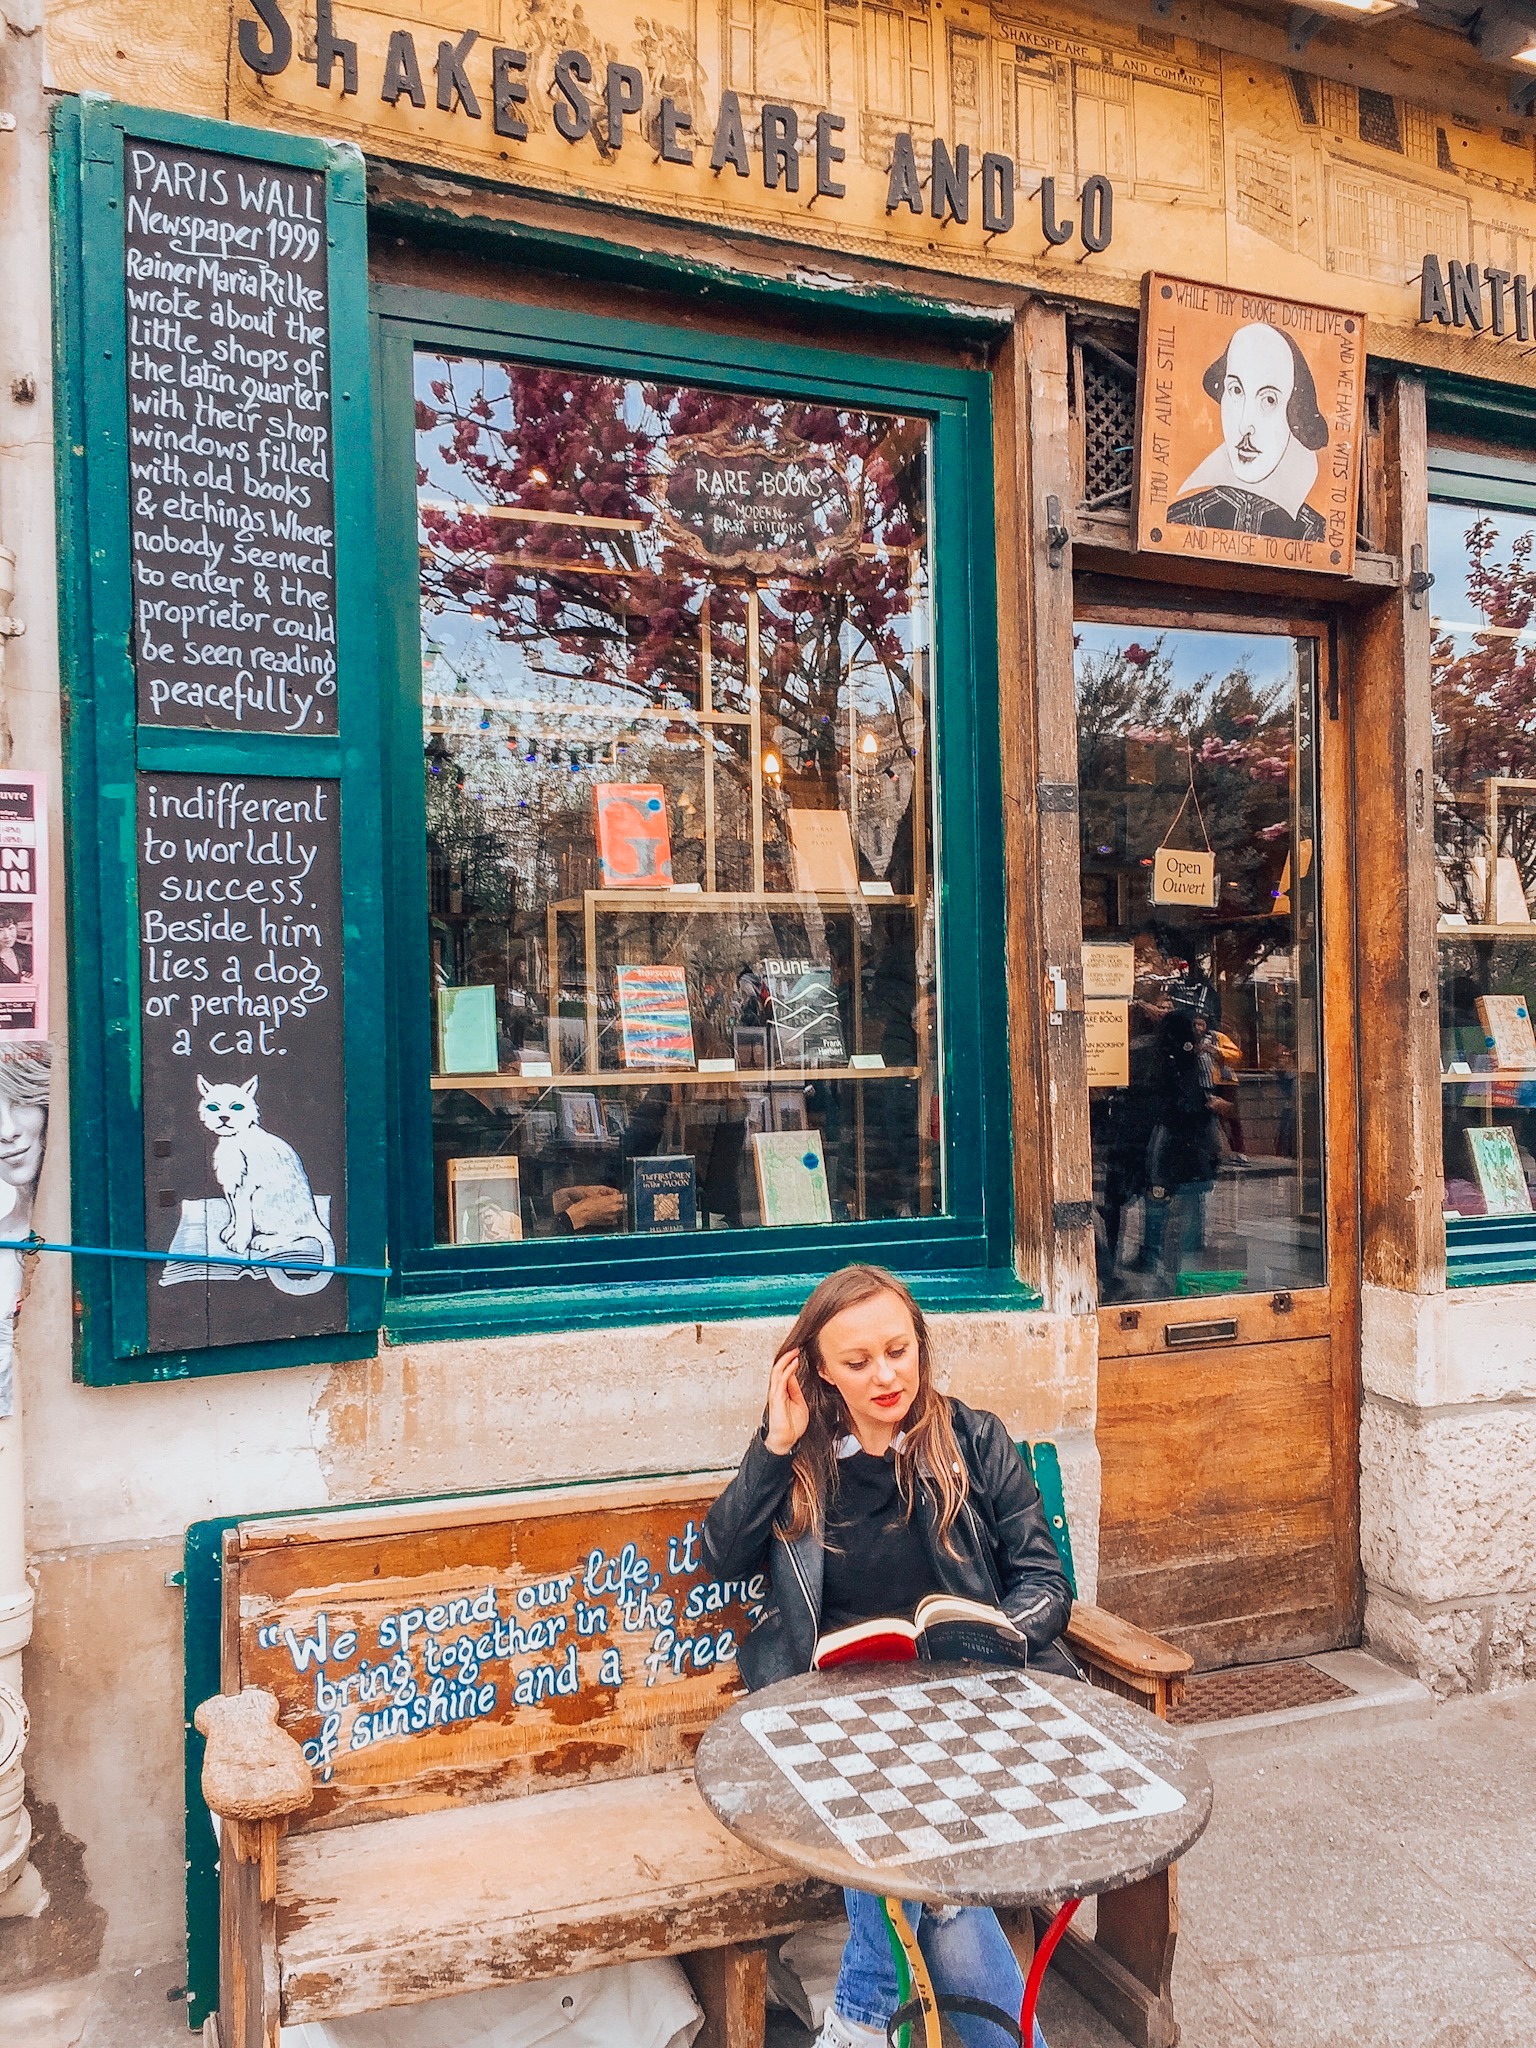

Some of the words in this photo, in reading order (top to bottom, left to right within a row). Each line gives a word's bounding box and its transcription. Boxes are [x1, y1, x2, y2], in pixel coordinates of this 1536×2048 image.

[1001, 25, 1089, 58] SHAKESPEARE
[1122, 59, 1148, 74] AND
[1153, 67, 1205, 88] COMPANY
[238, 0, 847, 199] SHAKESPEARE
[886, 132, 1014, 233] AND
[132, 150, 228, 206] PARIS
[238, 173, 321, 223] WALL
[128, 195, 262, 259] Newspaper
[267, 218, 319, 263] 1999
[127, 248, 196, 284] Rainer
[198, 257, 258, 299] Maria
[260, 267, 324, 313] Rilke
[1420, 254, 1536, 342] ANTI
[128, 286, 203, 320] wrote
[211, 301, 276, 338] about
[285, 312, 326, 348] the
[1174, 284, 1208, 312] WHILE
[1215, 292, 1237, 316] THY
[1241, 298, 1276, 324] BOOKE
[1282, 305, 1312, 330] DOTH
[1316, 311, 1342, 336] LIVE
[212, 334, 288, 378] shops
[294, 352, 324, 390] of
[1157, 325, 1176, 372] STILL
[1340, 335, 1355, 365] AND
[131, 351, 176, 381] the
[241, 376, 329, 412] quarter
[1155, 379, 1173, 426] ALIVE
[1339, 369, 1354, 391] WE
[132, 389, 187, 421] with
[195, 391, 260, 433] their
[265, 409, 328, 456] shop
[1335, 394, 1354, 431] HAVE
[131, 423, 250, 462] windows
[257, 438, 330, 482] filled
[1152, 434, 1170, 467] ART
[1332, 442, 1350, 480] WITS
[131, 457, 189, 488] with
[193, 460, 234, 494] old
[243, 466, 311, 508] books
[135, 487, 157, 520] &
[696, 468, 750, 496] RARE
[762, 471, 822, 498] BOOKS
[1150, 467, 1168, 505] THOU
[1331, 486, 1347, 505] TO
[1183, 530, 1208, 550] AND
[1212, 533, 1256, 557] PRAISE
[1264, 540, 1278, 559] TO
[1284, 542, 1313, 564] GIVE
[1327, 509, 1347, 548] READ
[134, 525, 225, 569] nobody
[230, 543, 332, 580] seemed
[137, 560, 164, 586] to
[171, 561, 244, 597] enter
[253, 571, 272, 605] &
[280, 577, 330, 611] the
[139, 598, 270, 639] proprietor
[273, 612, 336, 645] could
[142, 632, 176, 664] be
[183, 641, 243, 668] seen
[250, 644, 336, 696] reading
[150, 671, 324, 731] peacefully,
[148, 782, 328, 829] indifferent
[144, 828, 177, 864] to
[185, 829, 318, 880] worldly
[1166, 857, 1201, 877] Open
[160, 876, 318, 909] success.
[1162, 877, 1206, 895] Ouvert
[143, 908, 252, 943] Beside
[260, 908, 322, 947] him
[149, 947, 209, 983] lies
[221, 956, 241, 983] a
[254, 950, 329, 1003] dog
[769, 960, 810, 974] DUNE
[146, 993, 180, 1017] or
[190, 985, 307, 1028] perhaps
[1100, 1015, 1123, 1023] BOOKS
[172, 1029, 192, 1056] a
[210, 1020, 288, 1056] cat.
[379, 1584, 498, 1652] spend
[517, 1575, 574, 1609] our
[583, 1543, 661, 1606] life,
[668, 1520, 704, 1575] it
[316, 1652, 416, 1713] bring
[425, 1615, 566, 1685] together
[576, 1602, 608, 1635] in
[623, 1588, 675, 1632] the
[686, 1574, 766, 1619] same
[301, 1711, 341, 1783] of
[351, 1676, 497, 1750] sunshine
[513, 1645, 578, 1705] and
[600, 1649, 623, 1687] a
[646, 1628, 738, 1688] free
